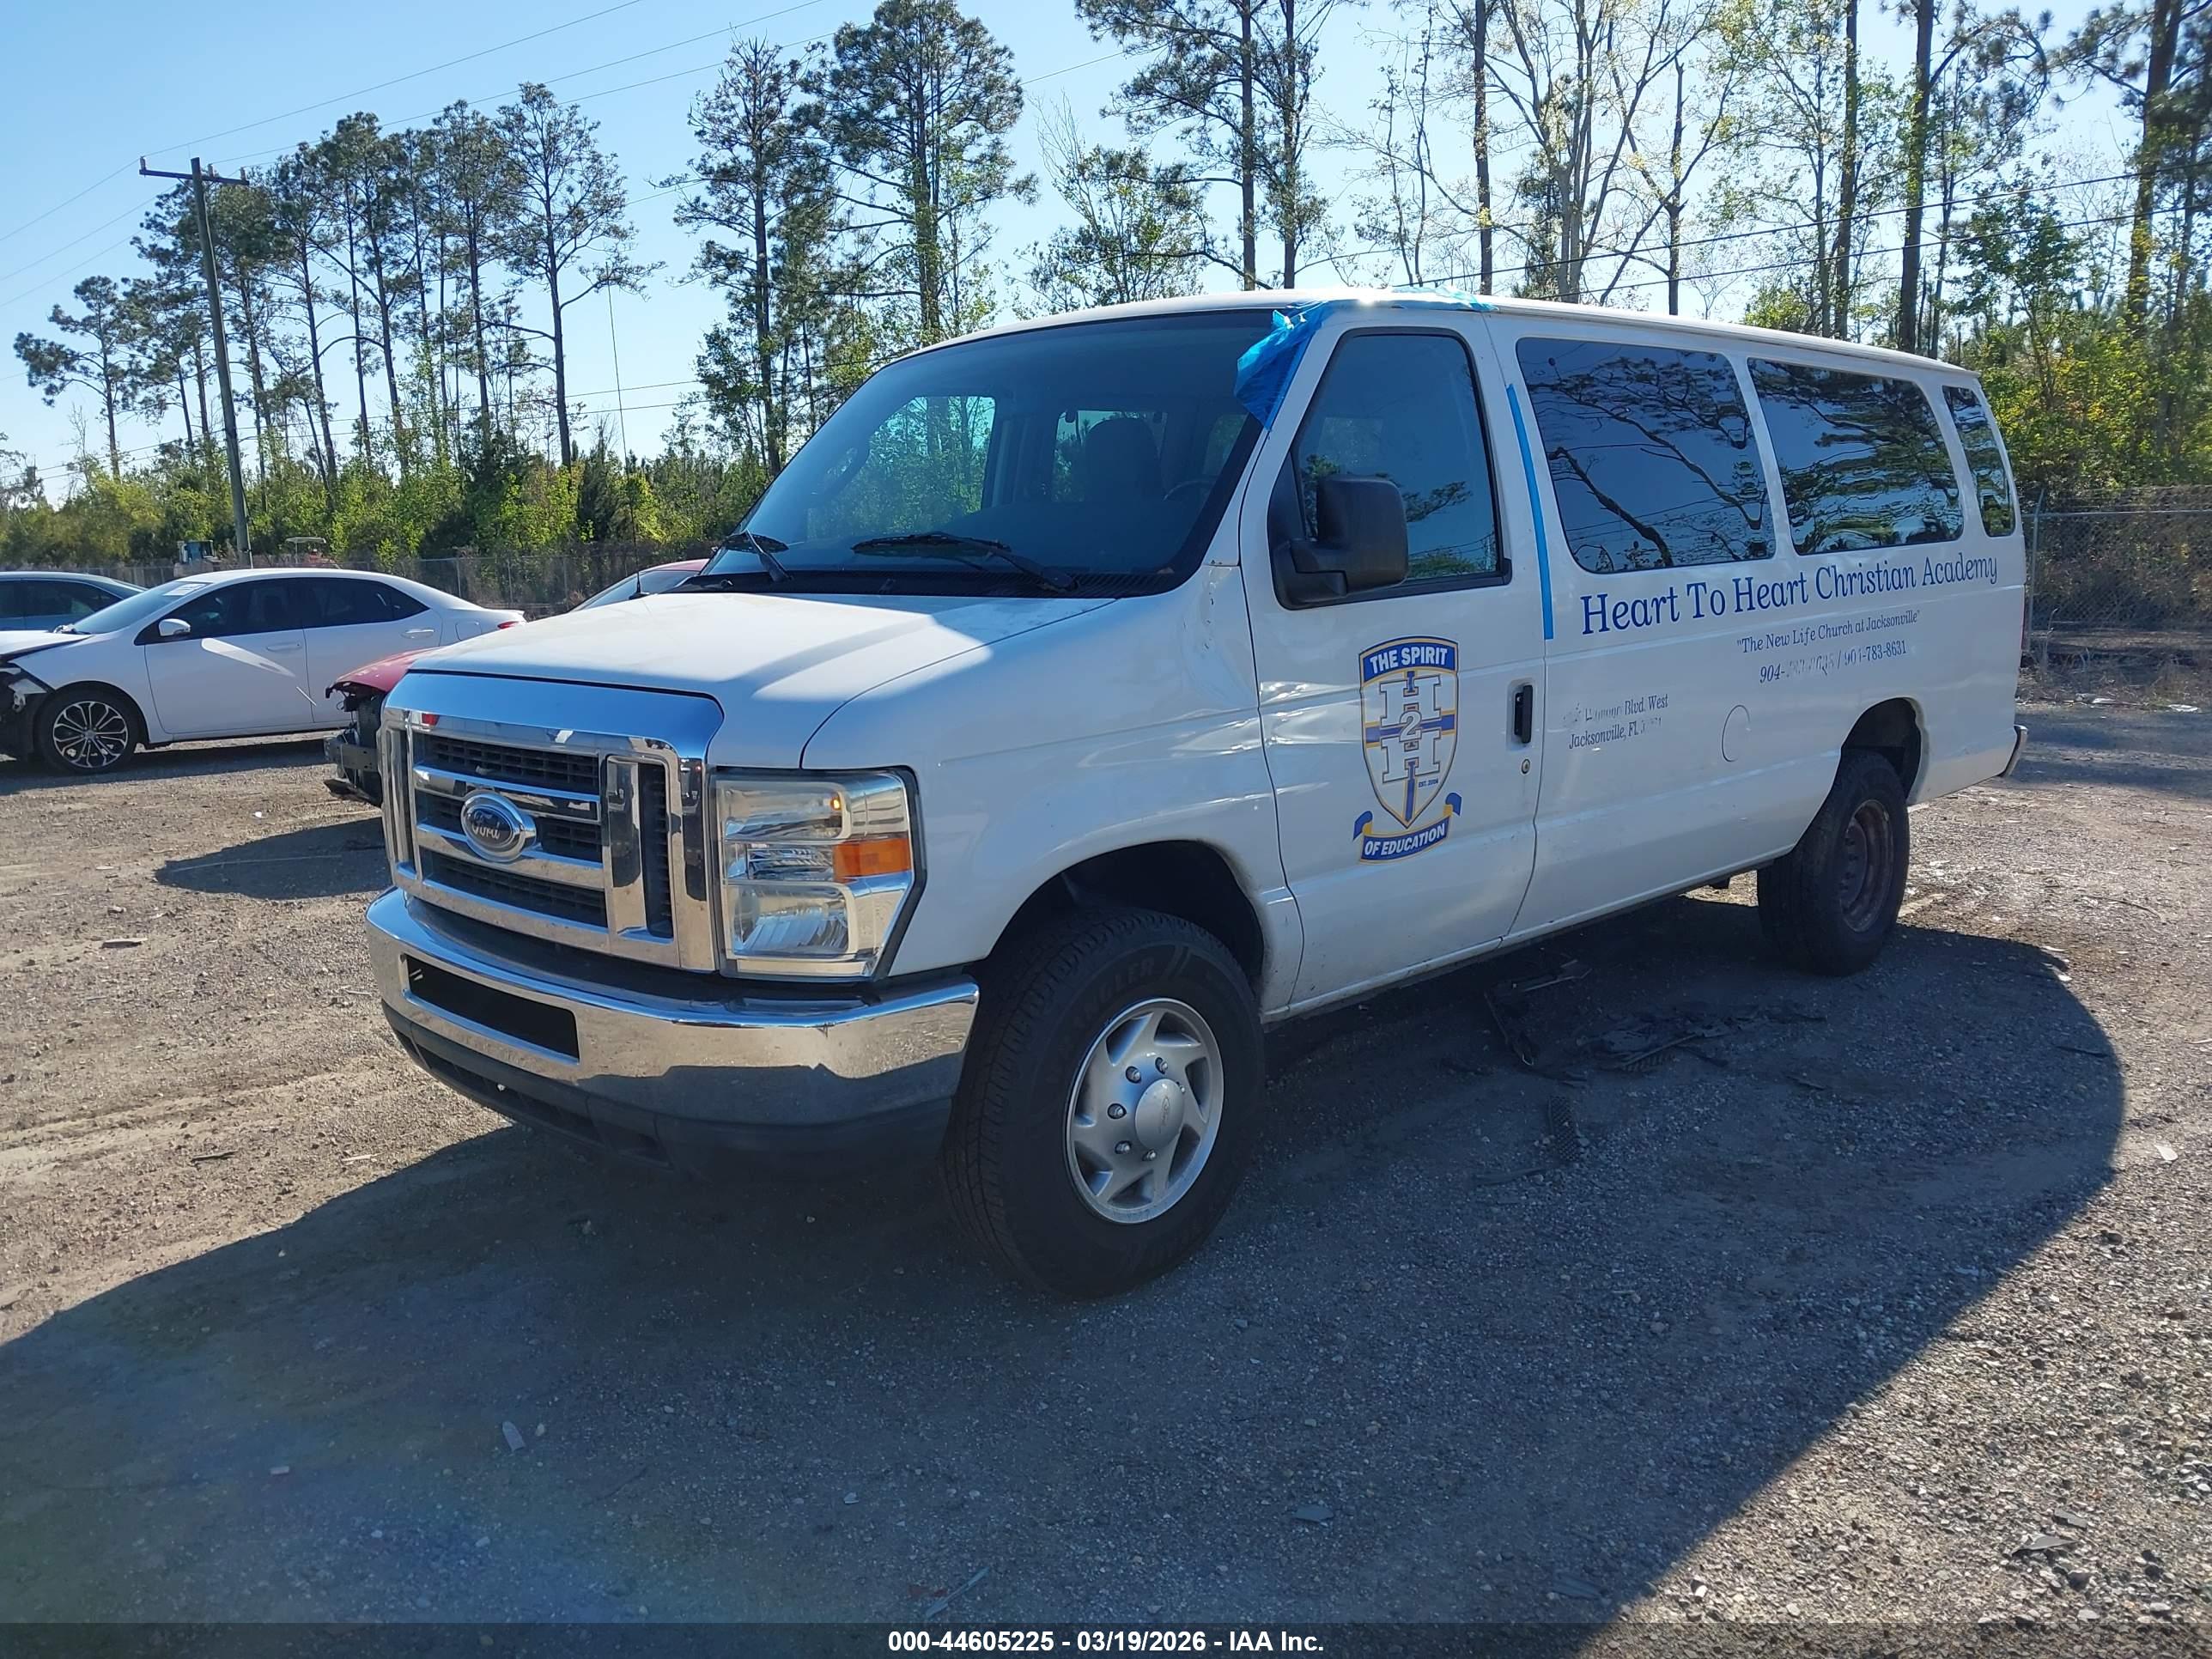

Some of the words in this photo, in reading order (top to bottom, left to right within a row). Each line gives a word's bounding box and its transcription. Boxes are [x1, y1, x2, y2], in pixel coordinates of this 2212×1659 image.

[1580, 586, 1680, 635] Heart
[1686, 581, 1726, 619] To
[1732, 571, 1809, 613] Heart
[1815, 560, 1917, 599] Christian
[1922, 552, 1997, 586] Academy
[1765, 633, 1790, 650] New
[1792, 627, 1816, 646] Life
[1818, 620, 1853, 640] Church
[1855, 620, 1865, 633] at
[1370, 650, 1399, 674] THE
[1401, 646, 1448, 665] SPIRIT
[1648, 693, 1668, 711] West
[1399, 710, 1423, 743] 2
[1569, 724, 1626, 749] Jacksonville,
[1364, 840, 1382, 856] OF
[1381, 823, 1445, 856] EDUCATION
